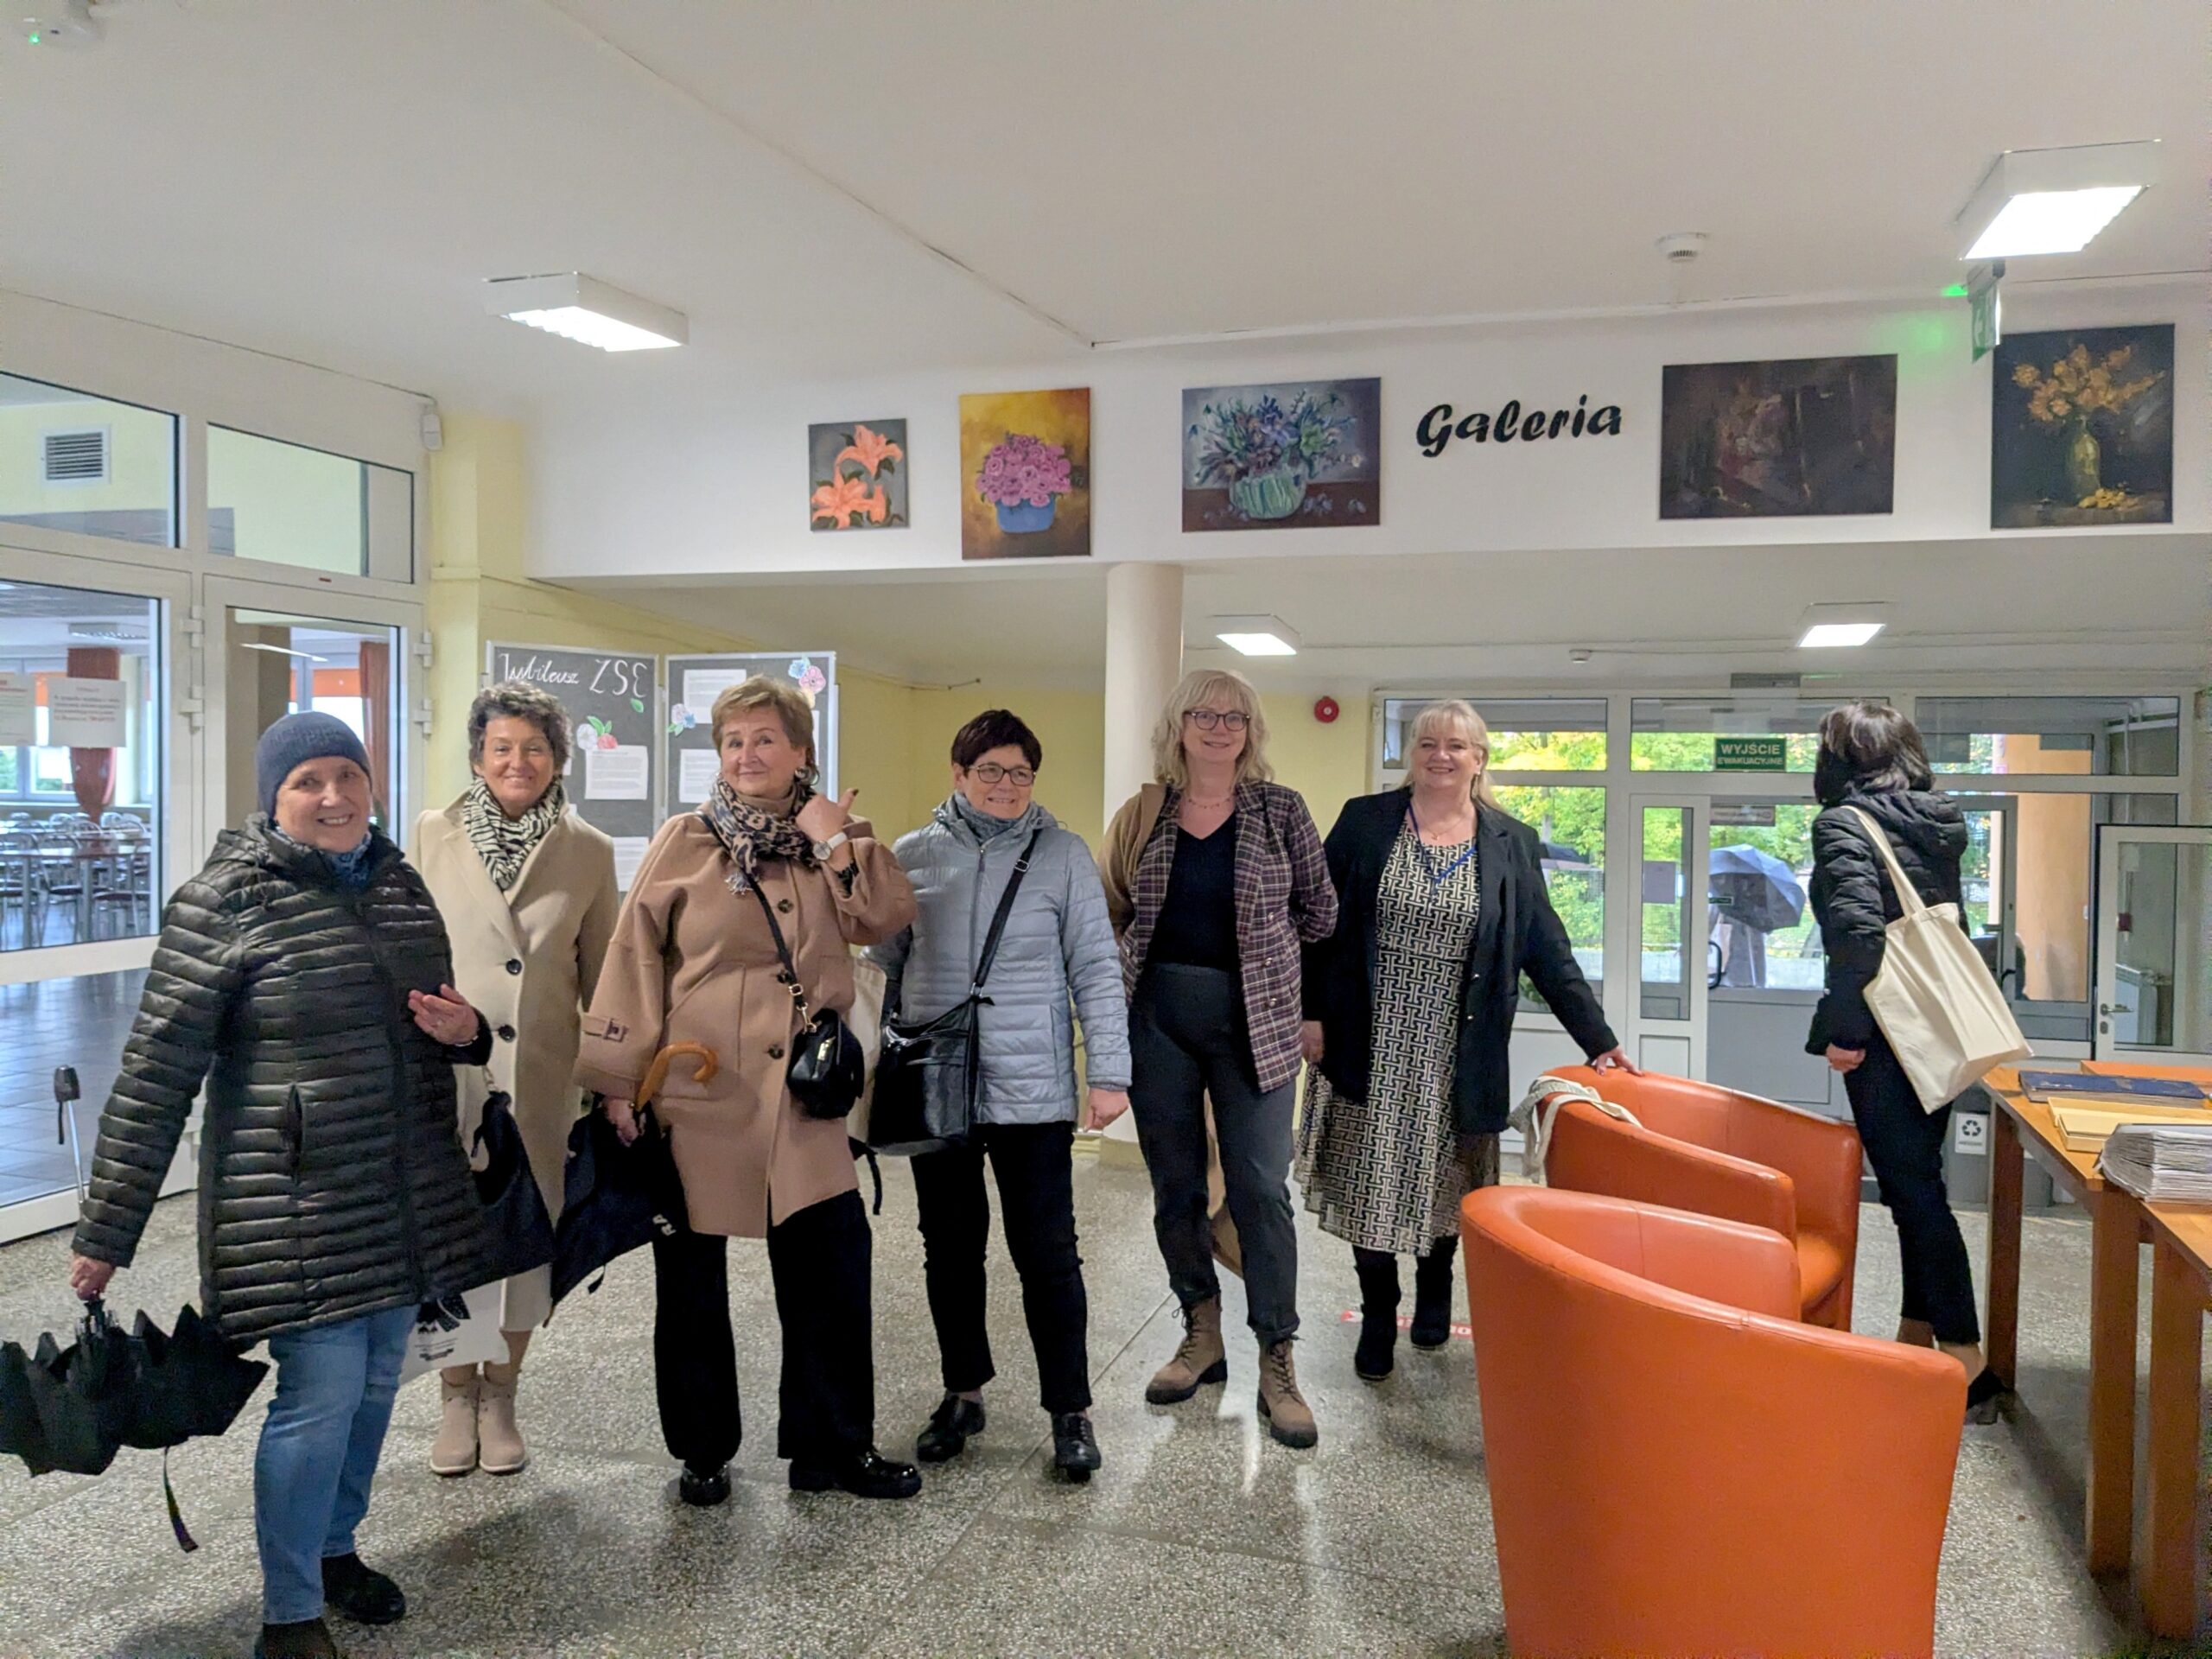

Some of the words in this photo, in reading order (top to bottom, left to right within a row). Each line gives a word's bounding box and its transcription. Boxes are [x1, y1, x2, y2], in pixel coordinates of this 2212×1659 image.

[1416, 394, 1622, 457] Galeria
[589, 659, 647, 698] ZSE
[1721, 742, 1780, 754] WYJŚCIE
